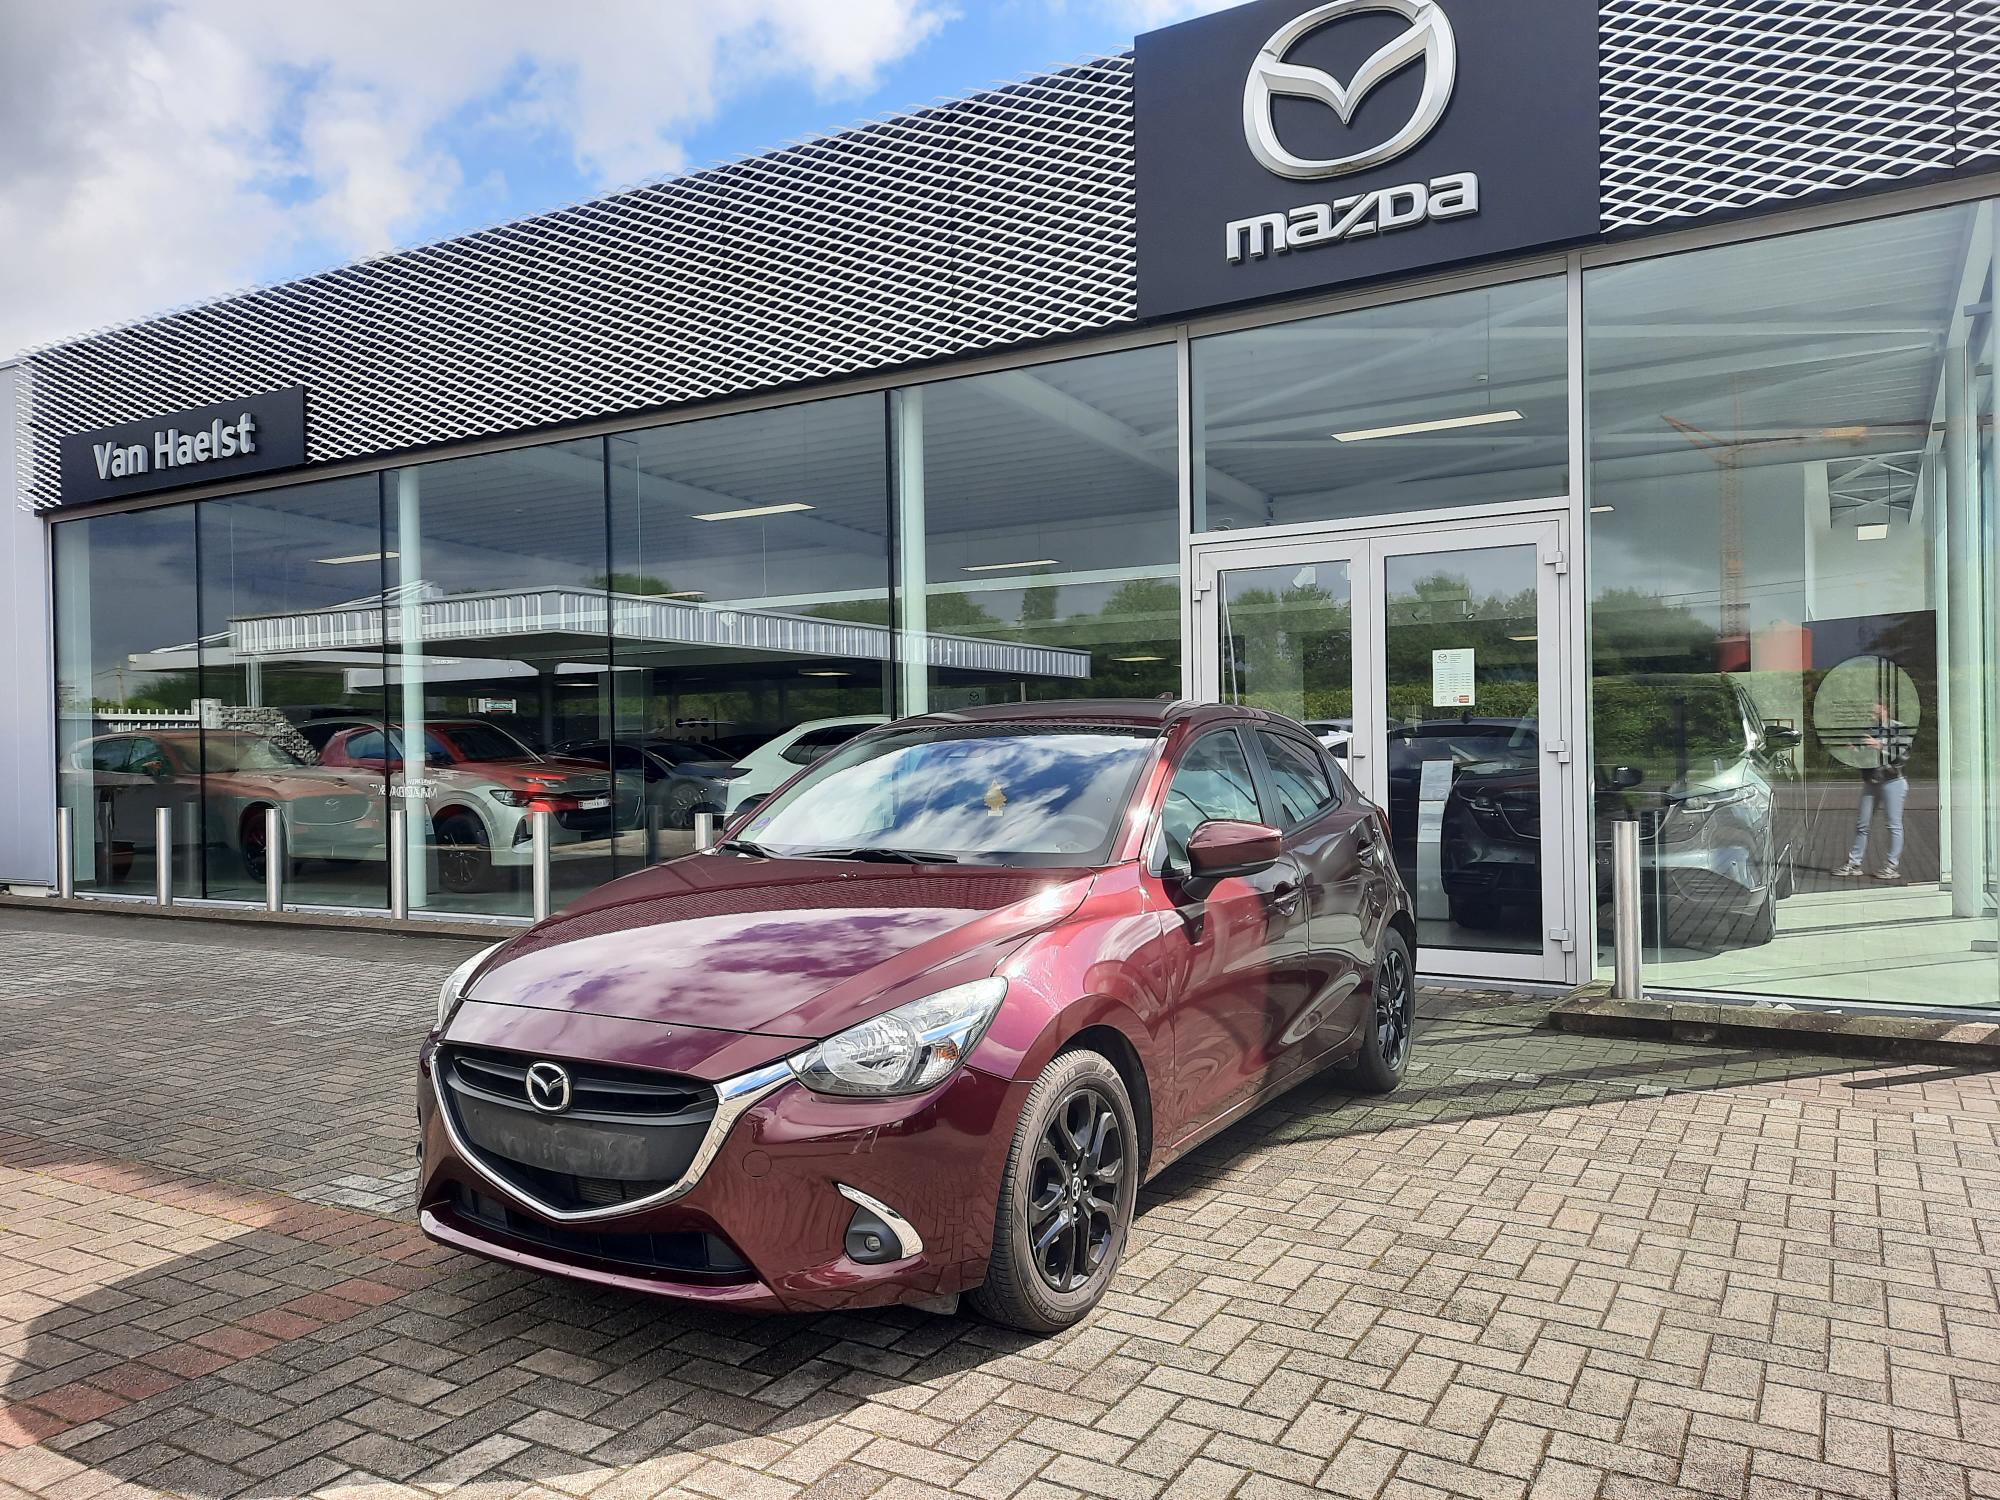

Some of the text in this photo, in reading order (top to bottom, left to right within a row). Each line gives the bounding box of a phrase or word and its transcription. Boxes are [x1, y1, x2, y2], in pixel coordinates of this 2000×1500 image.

[1226, 171, 1479, 263] mazda
[93, 412, 256, 480] Van Haelst
